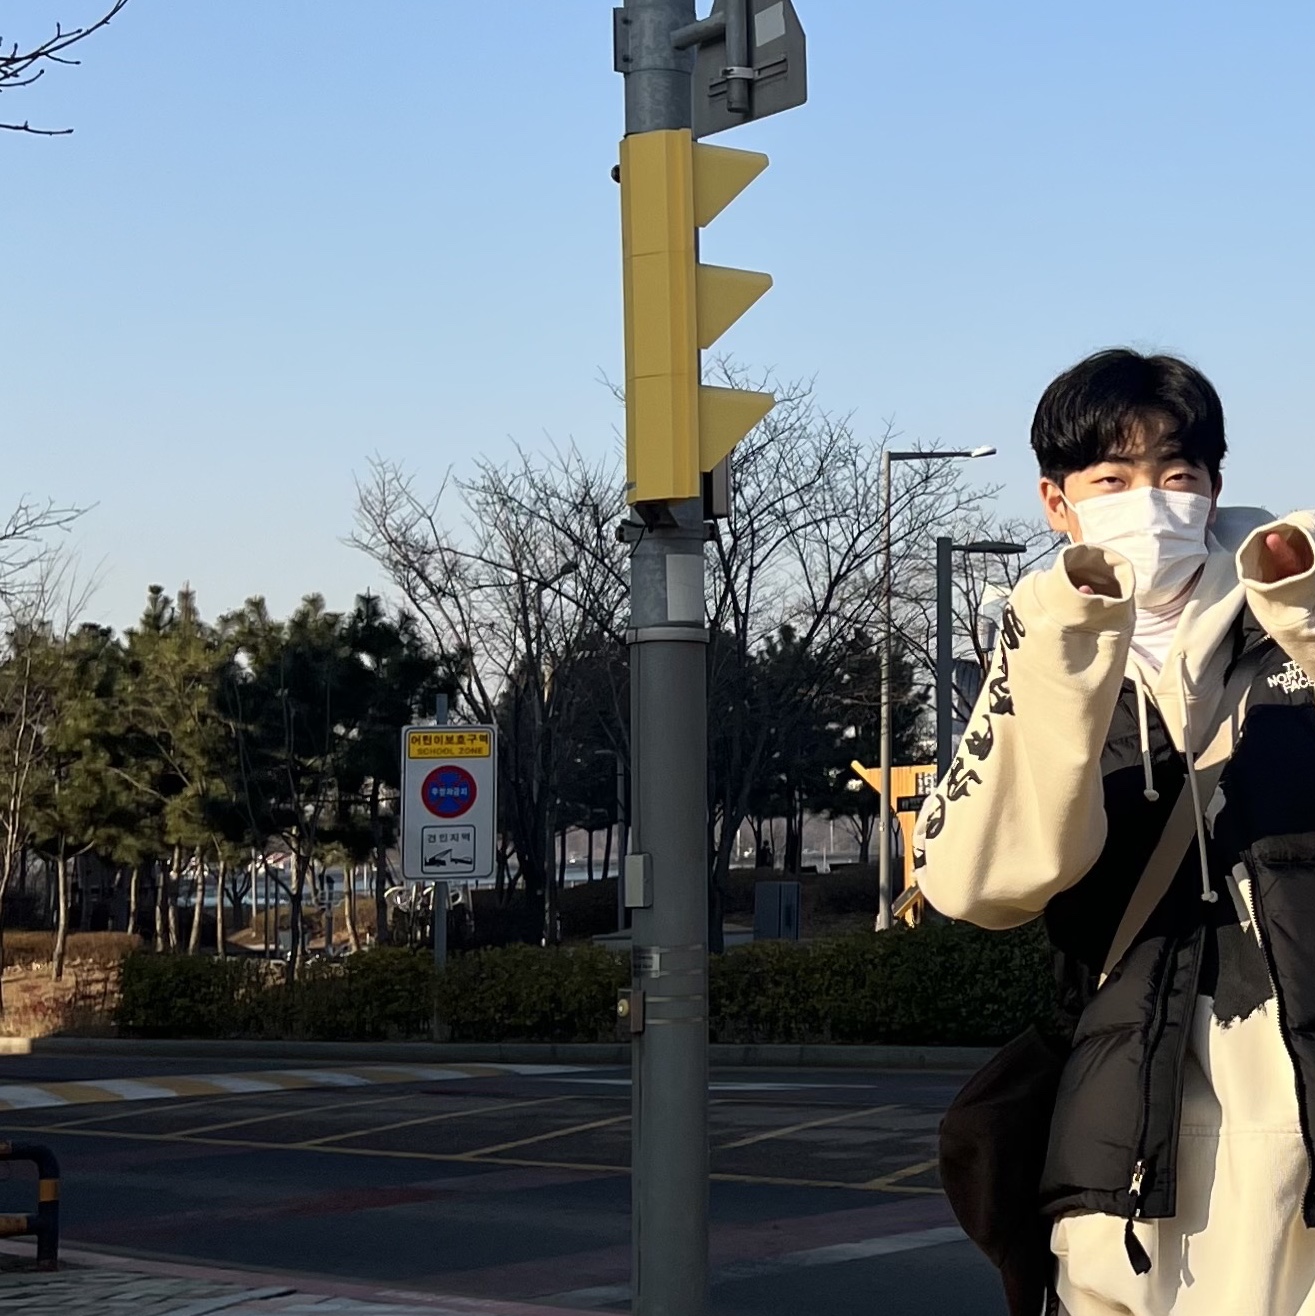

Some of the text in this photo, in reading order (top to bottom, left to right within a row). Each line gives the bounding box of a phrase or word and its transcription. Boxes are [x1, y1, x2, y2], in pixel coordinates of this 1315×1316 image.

[1267, 668, 1303, 688] NORT
[411, 734, 488, 745] 어린이보호구역
[417, 747, 483, 755] SCHOOL ZONE
[428, 832, 471, 843] 견인지역
